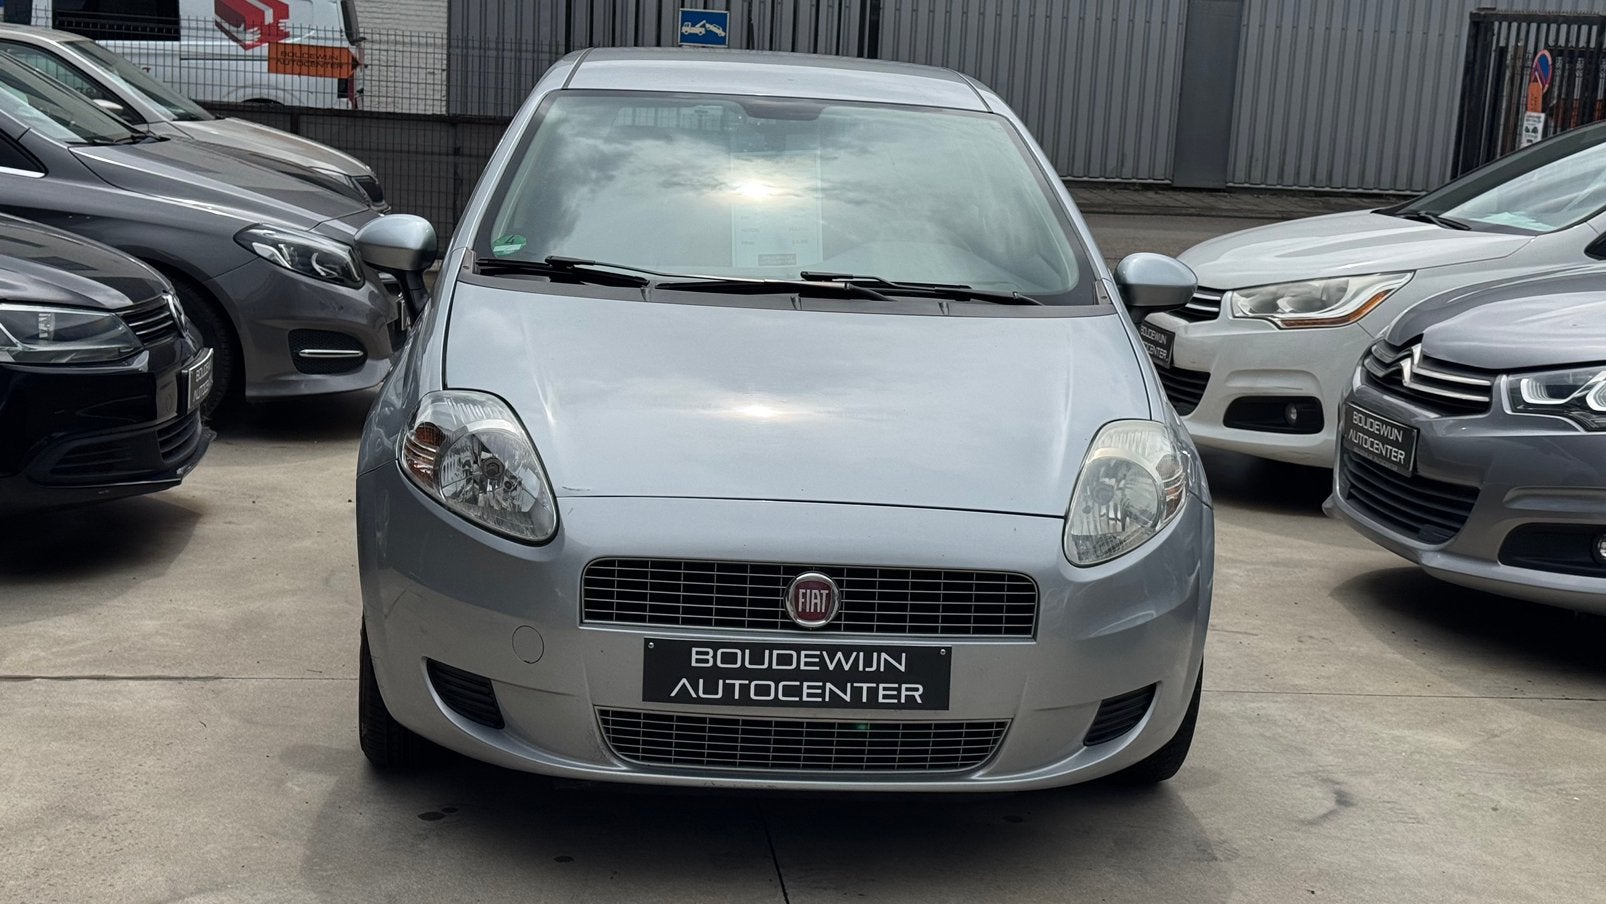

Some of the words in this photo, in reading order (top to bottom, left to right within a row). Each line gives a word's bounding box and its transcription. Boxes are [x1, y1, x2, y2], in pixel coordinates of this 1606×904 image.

[1352, 411, 1403, 443] BOUDEWIJN
[1348, 429, 1406, 464] AUTOCENTER
[798, 588, 829, 613] FIAT
[691, 646, 906, 673] BOUDEWIJN
[669, 677, 924, 704] AUTOCENTER
